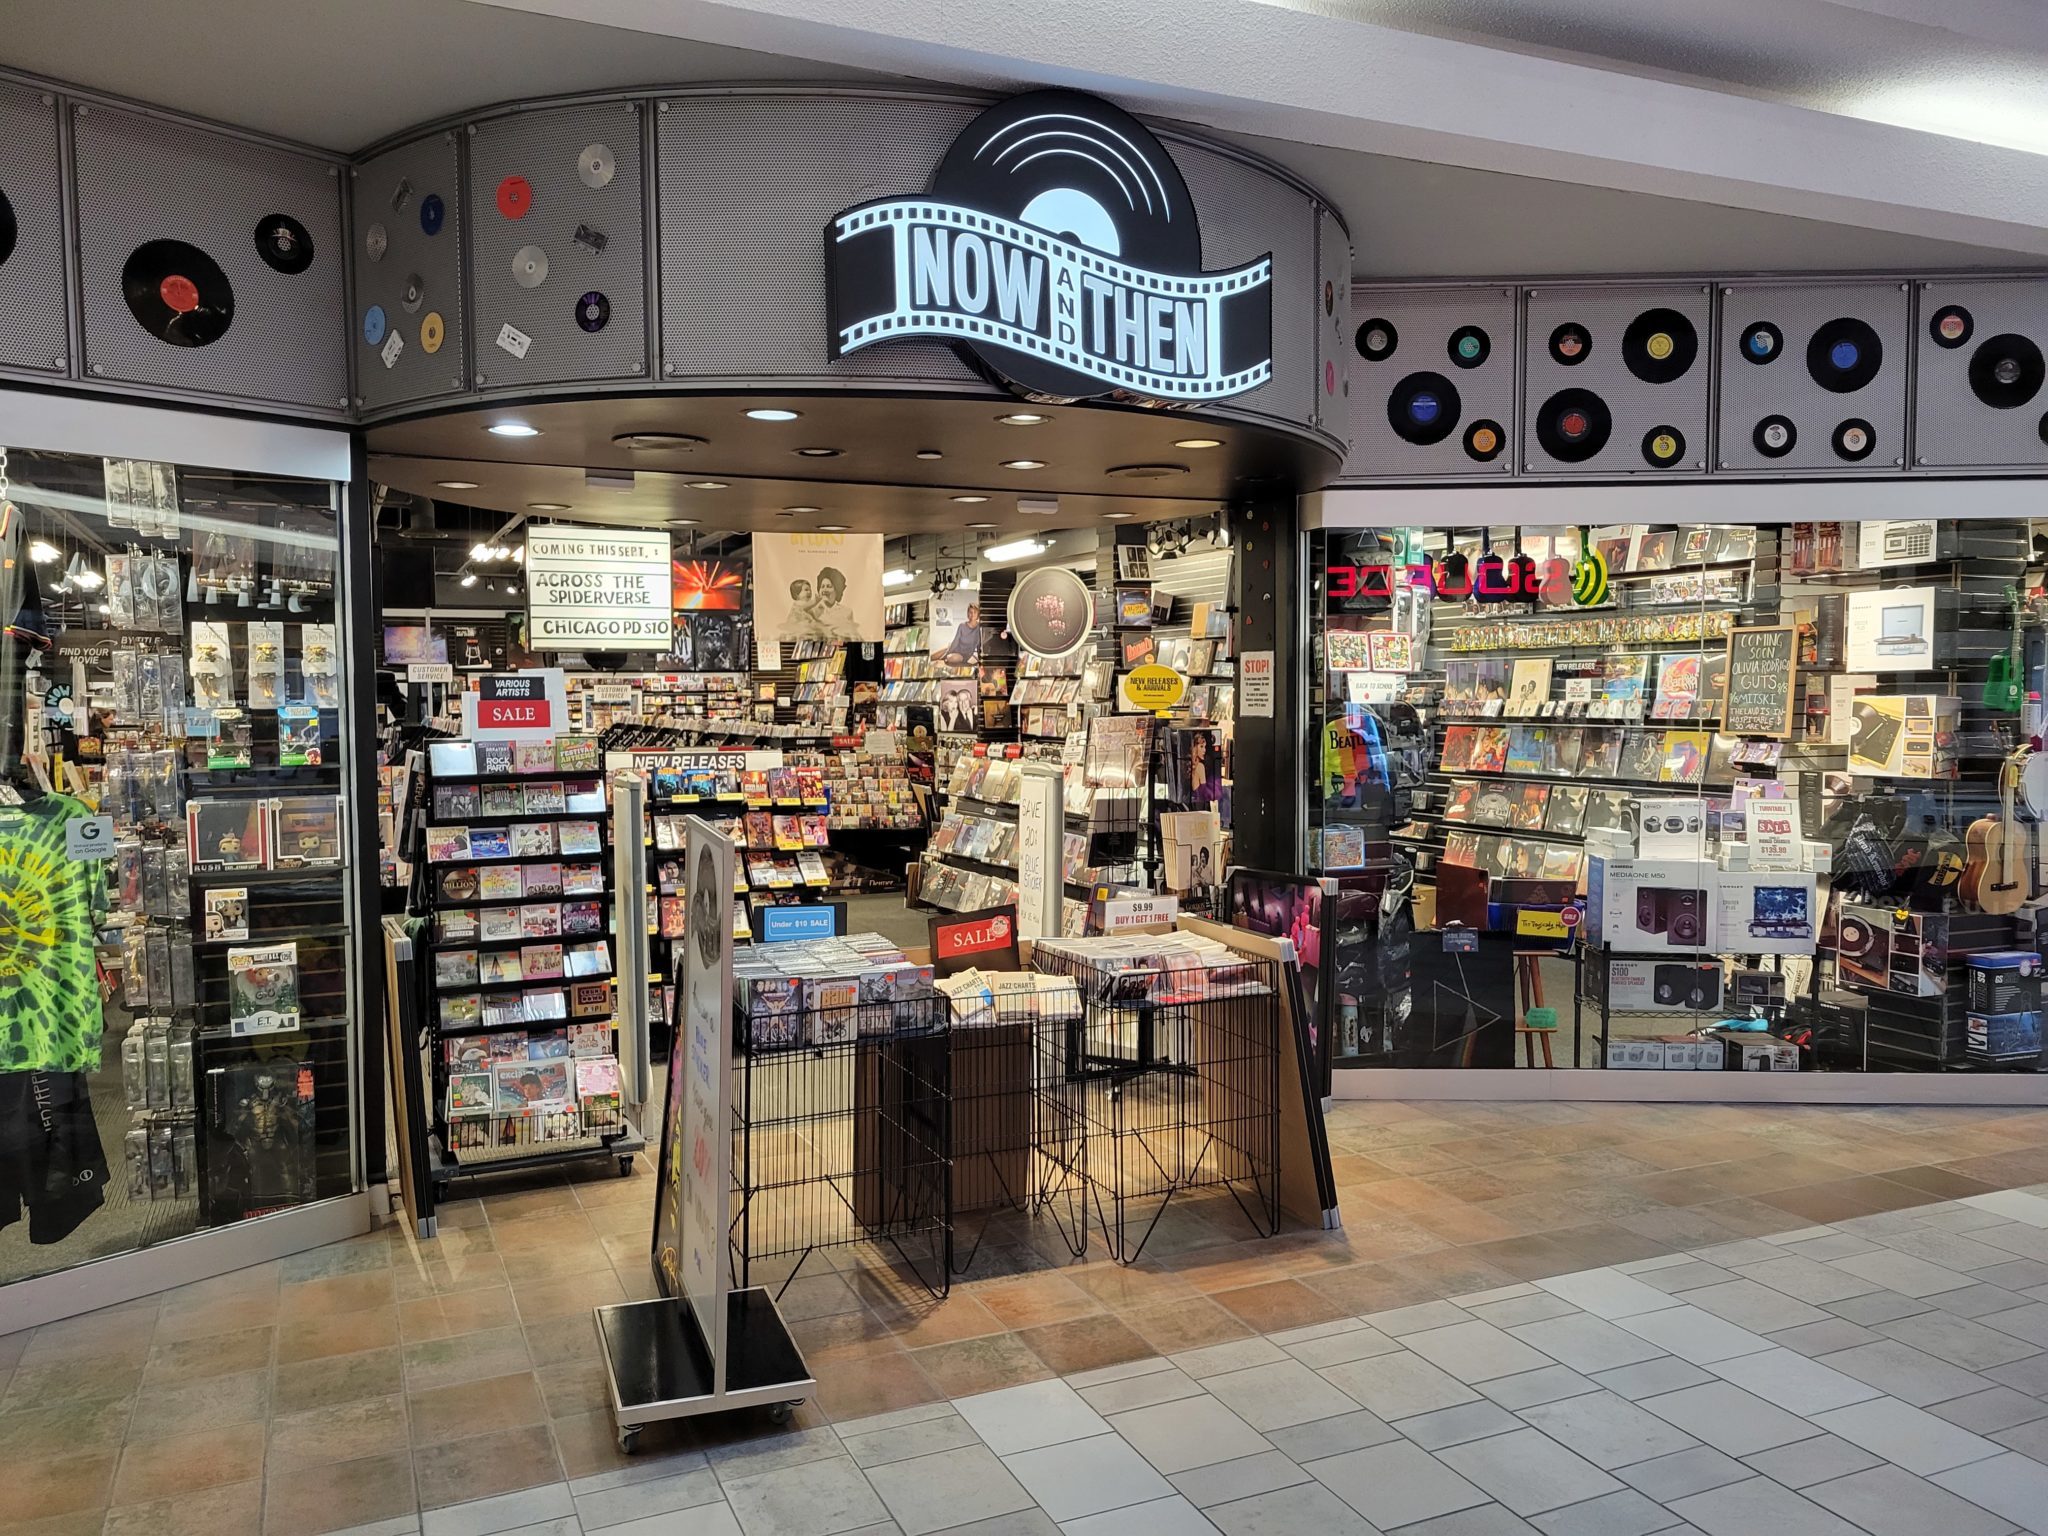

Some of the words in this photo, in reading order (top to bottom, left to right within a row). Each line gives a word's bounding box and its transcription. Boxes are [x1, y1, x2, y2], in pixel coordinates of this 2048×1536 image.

[913, 227, 1043, 331] NOW
[1057, 268, 1076, 345] AND
[1084, 276, 1203, 375] THEN
[532, 544, 584, 555] COMING
[589, 544, 617, 556] THIS
[536, 574, 603, 588] ACROSS
[613, 576, 645, 589] THE
[549, 591, 650, 605] SPIDERVERSE
[543, 620, 620, 634] CHICAGO
[623, 620, 642, 634] PD
[644, 621, 669, 635] S10
[121, 636, 134, 644] BY
[1741, 633, 1784, 648] COMING
[59, 648, 81, 656] FIND
[83, 648, 109, 656] YOUR
[1749, 647, 1775, 659] SOON
[69, 656, 99, 664] MOVIE
[412, 666, 448, 674] CUSTOMER
[1245, 660, 1270, 673] STOP!
[1732, 661, 1760, 675] OLIVIA
[1761, 659, 1790, 674] RODRIGO
[495, 680, 530, 689] VARIOUS
[1741, 675, 1777, 689] GUTS
[47, 685, 70, 706] NOW
[496, 688, 530, 697] ARTISTS
[1739, 693, 1776, 704] MITSKI
[492, 707, 536, 721] SALE
[1730, 716, 1774, 725] HOSPITABLE
[634, 755, 669, 769] NEW
[672, 755, 745, 769] RELEASES
[1022, 799, 1042, 819] SAVE
[1759, 823, 1790, 833] SALE
[429, 837, 456, 845] BACK
[194, 864, 221, 872] RUSH
[1025, 854, 1039, 874] BLUE
[1132, 903, 1153, 912] $9.99
[771, 920, 793, 929] Under
[795, 920, 808, 928] $10
[810, 919, 828, 927] SALE
[1115, 916, 1130, 925] BUY
[1136, 915, 1148, 923] GET
[1154, 913, 1169, 922] FREE
[953, 931, 995, 948] SALE
[1611, 967, 1629, 976] S100
[951, 985, 964, 996] JAZZ
[962, 976, 982, 990] CHARTS
[1013, 981, 1036, 989] CHARTS
[258, 1016, 271, 1026] E.T.
